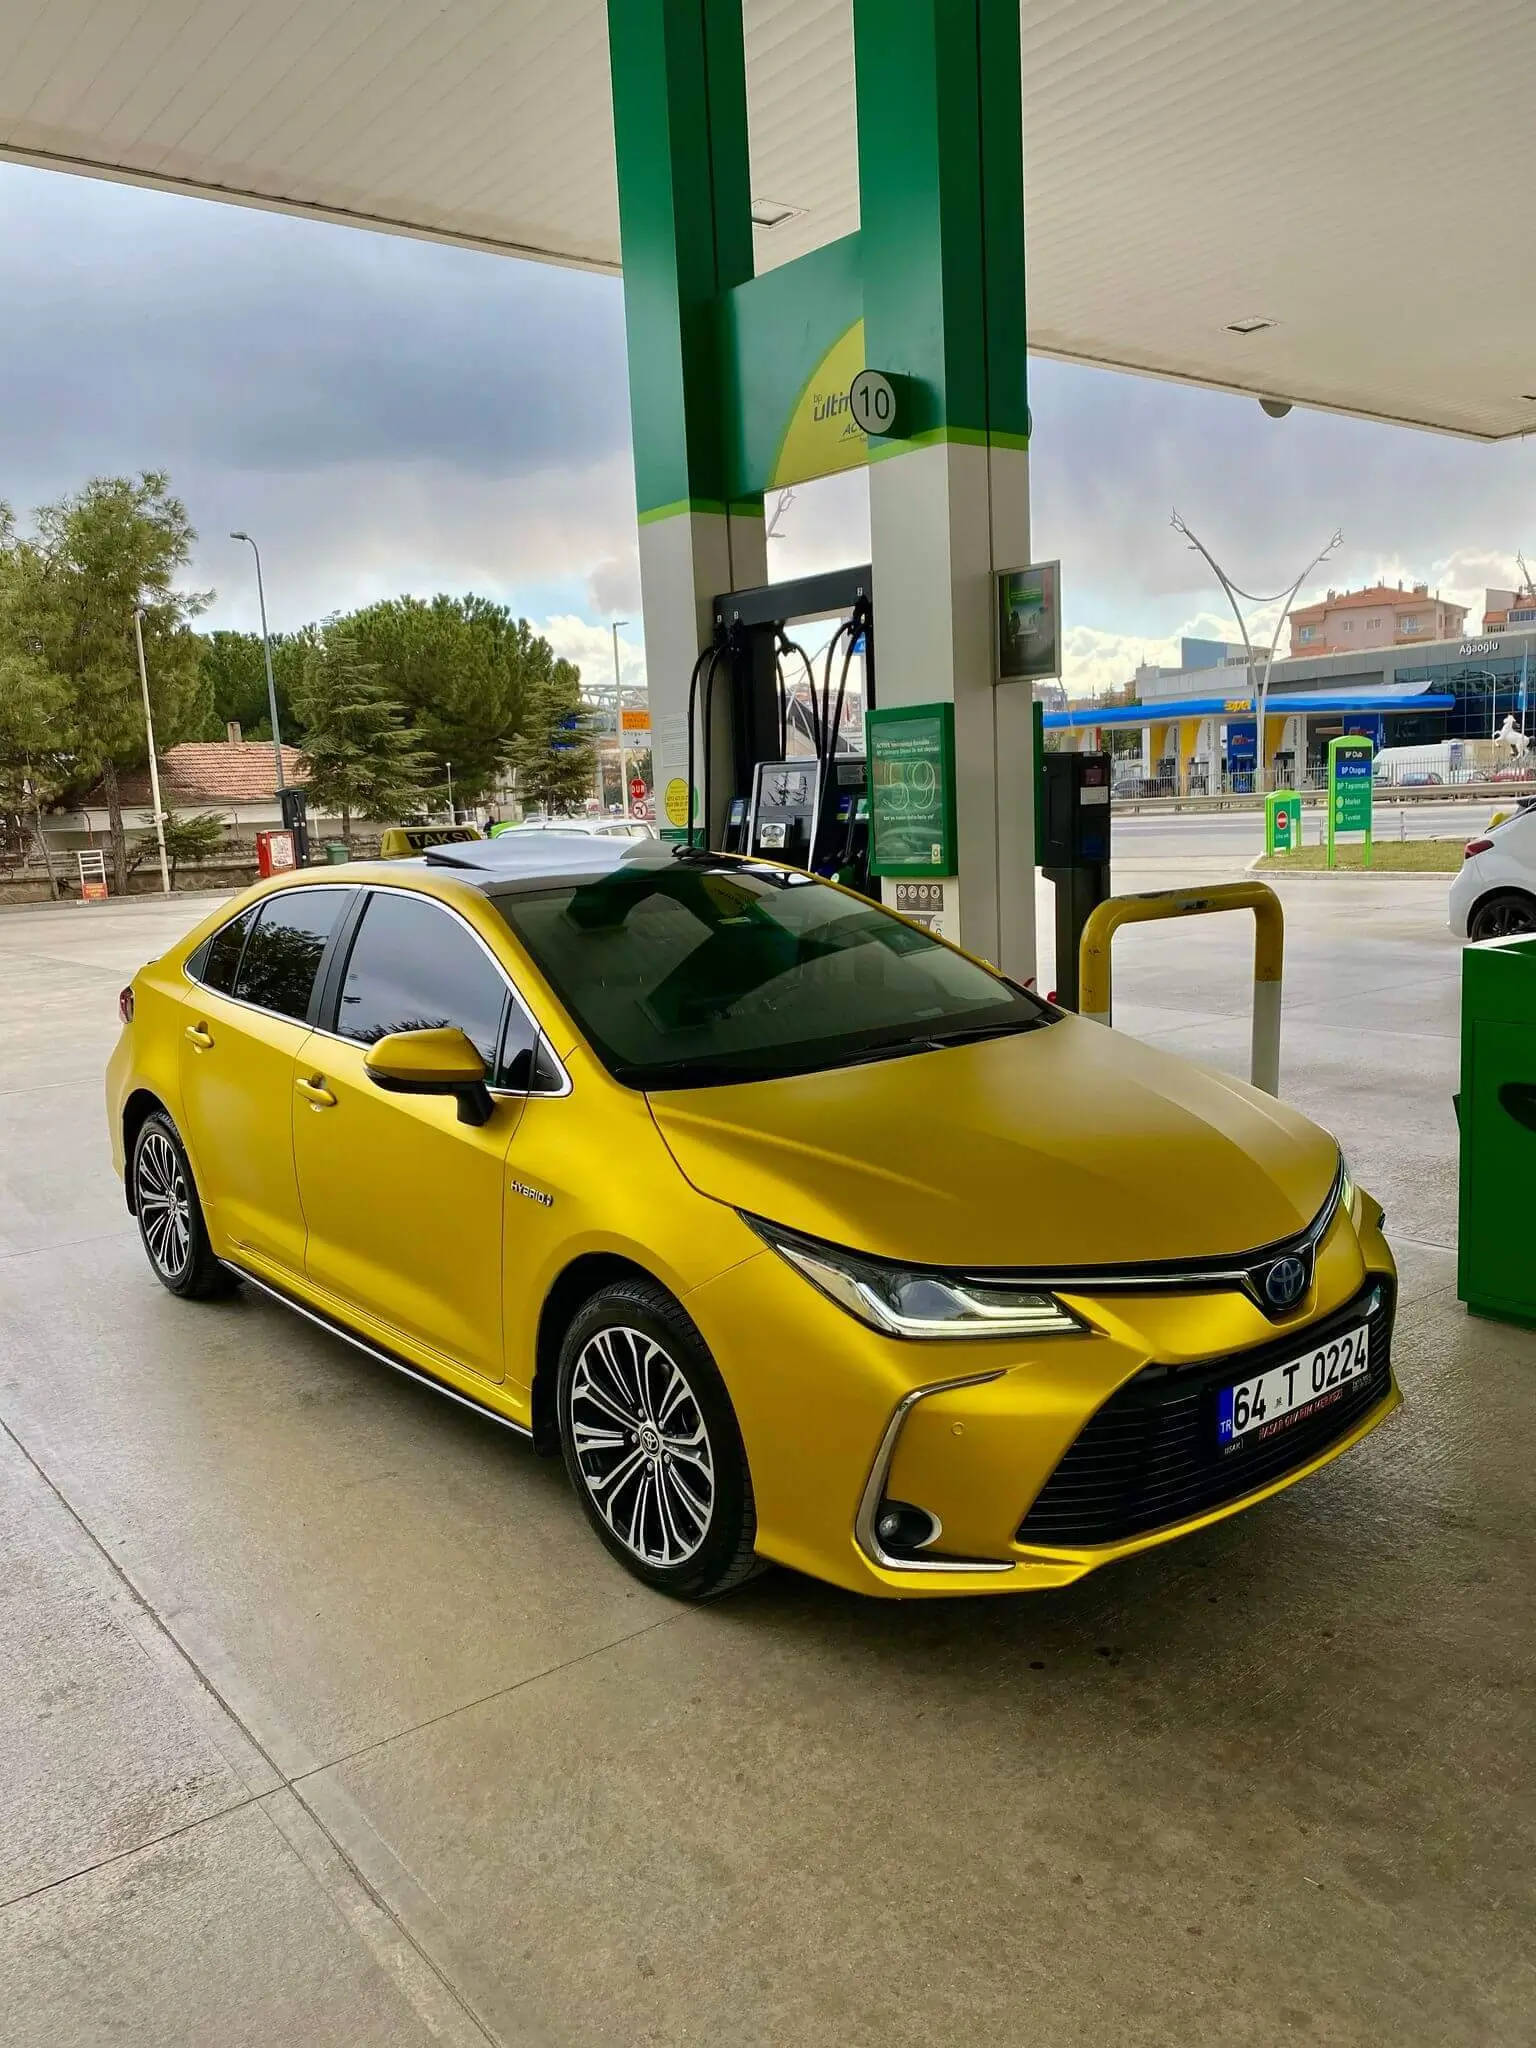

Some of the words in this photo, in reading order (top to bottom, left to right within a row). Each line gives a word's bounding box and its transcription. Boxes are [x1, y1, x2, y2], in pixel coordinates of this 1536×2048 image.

[860, 386, 889, 419] 10
[1459, 640, 1499, 656] Ağaoğlu
[631, 785, 645, 793] DUR
[510, 1179, 545, 1204] HYBRID
[1233, 1378, 1266, 1431] 64
[1282, 1362, 1300, 1407] T
[1311, 1330, 1366, 1393] 0224
[1220, 1418, 1232, 1434] TR
